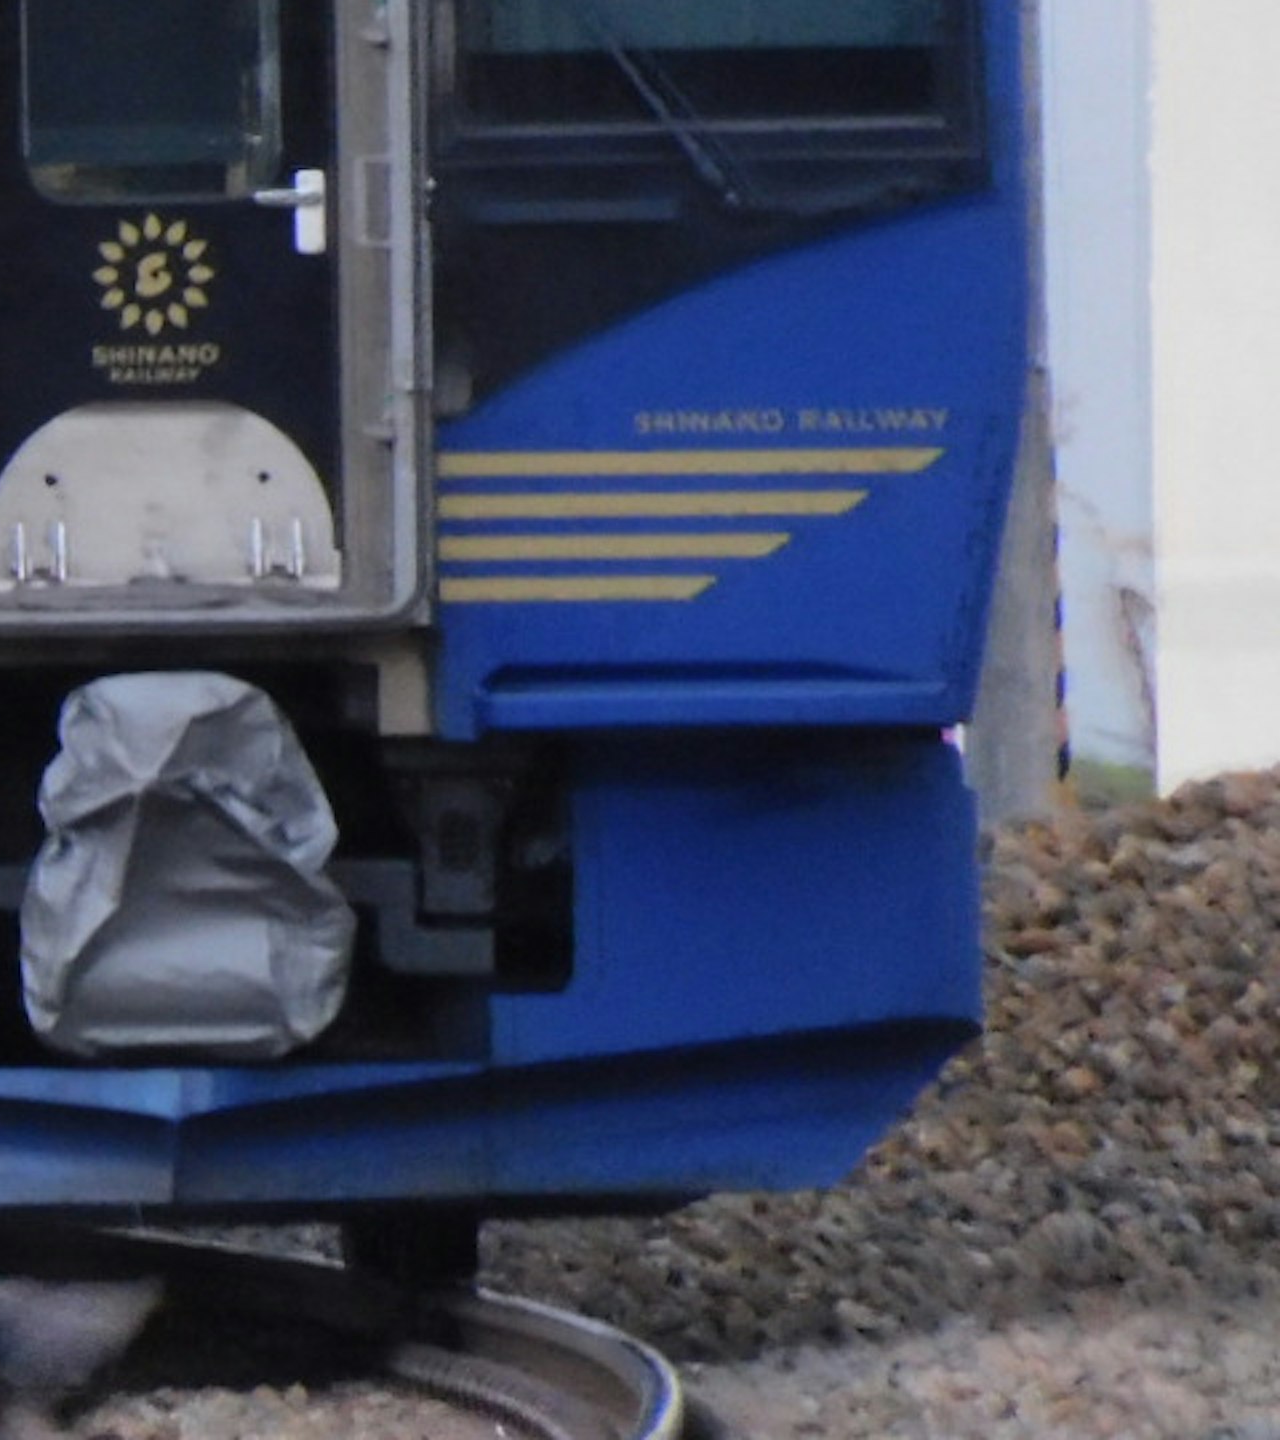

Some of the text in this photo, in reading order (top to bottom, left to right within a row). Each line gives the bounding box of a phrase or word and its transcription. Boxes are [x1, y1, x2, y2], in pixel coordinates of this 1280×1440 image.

[92, 343, 220, 364] SHINANO
[634, 407, 949, 434] SHINANO RAILWAY
